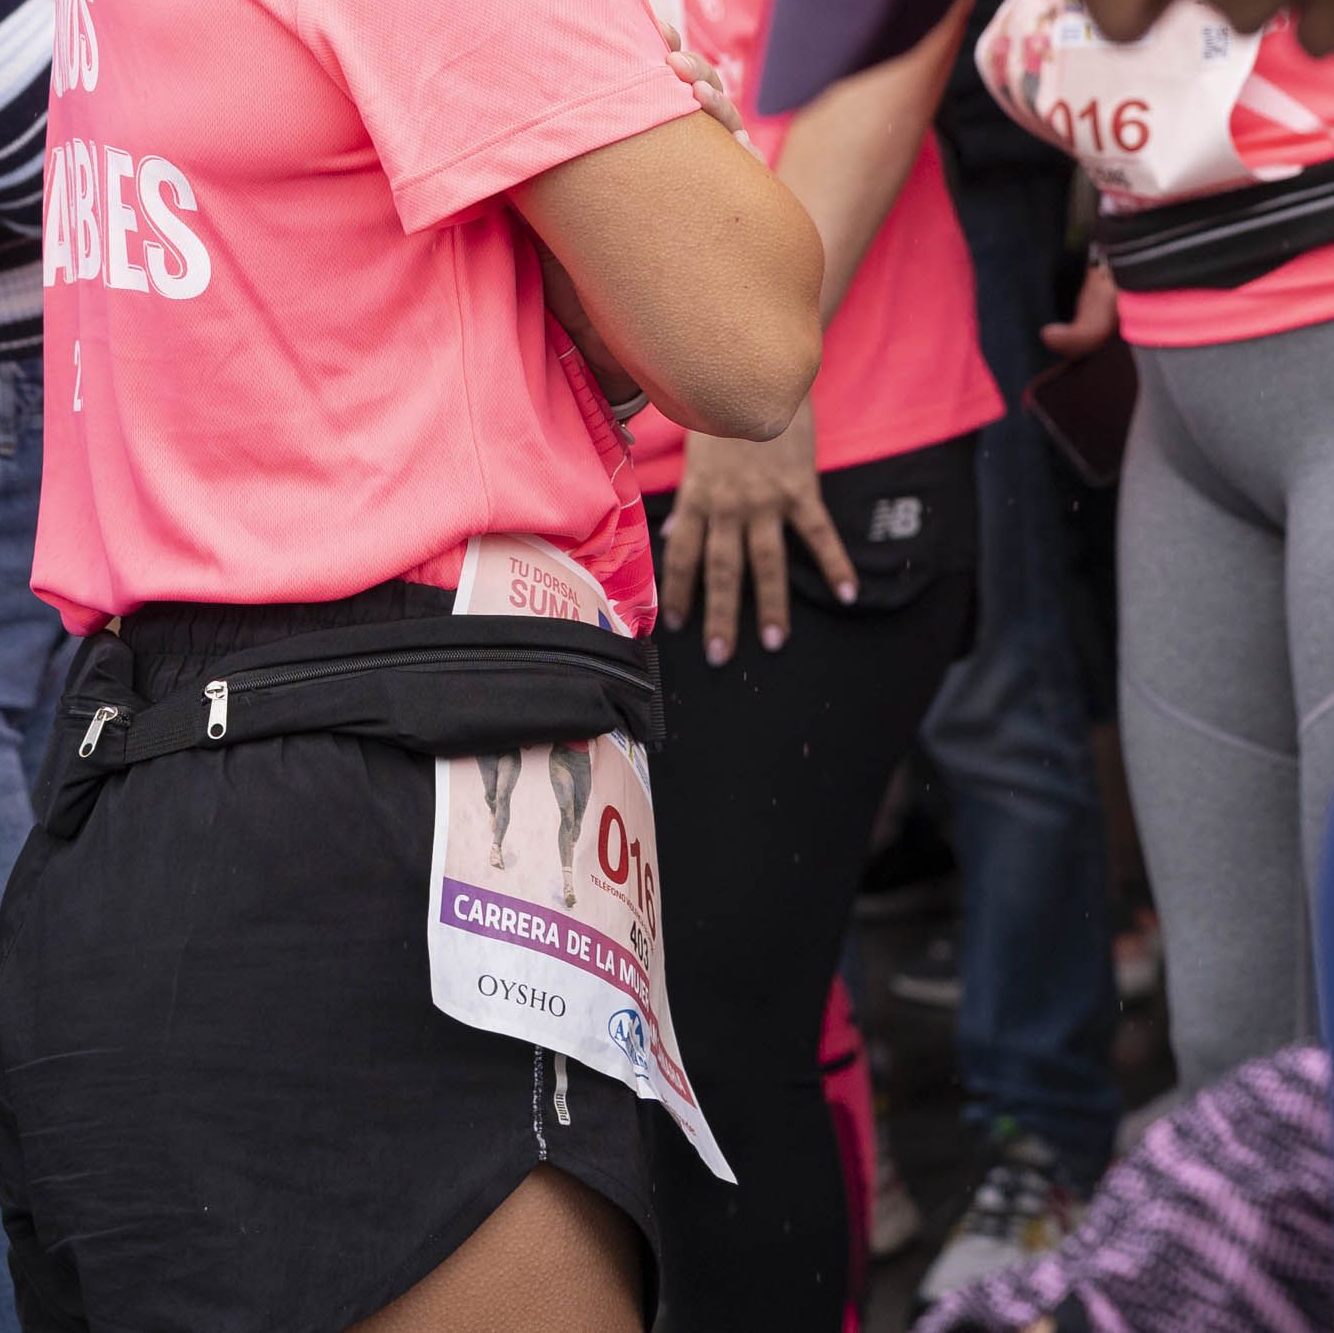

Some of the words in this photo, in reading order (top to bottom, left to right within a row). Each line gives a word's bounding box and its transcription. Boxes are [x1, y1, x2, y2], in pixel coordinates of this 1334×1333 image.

[509, 556, 530, 578] TU
[533, 567, 582, 609] DORSAL
[509, 579, 581, 622] SUMA
[597, 804, 657, 942] 016
[453, 893, 561, 949] CARRERA
[567, 929, 592, 963] DE
[596, 943, 616, 977] LA
[477, 974, 567, 1018] OYSHO
